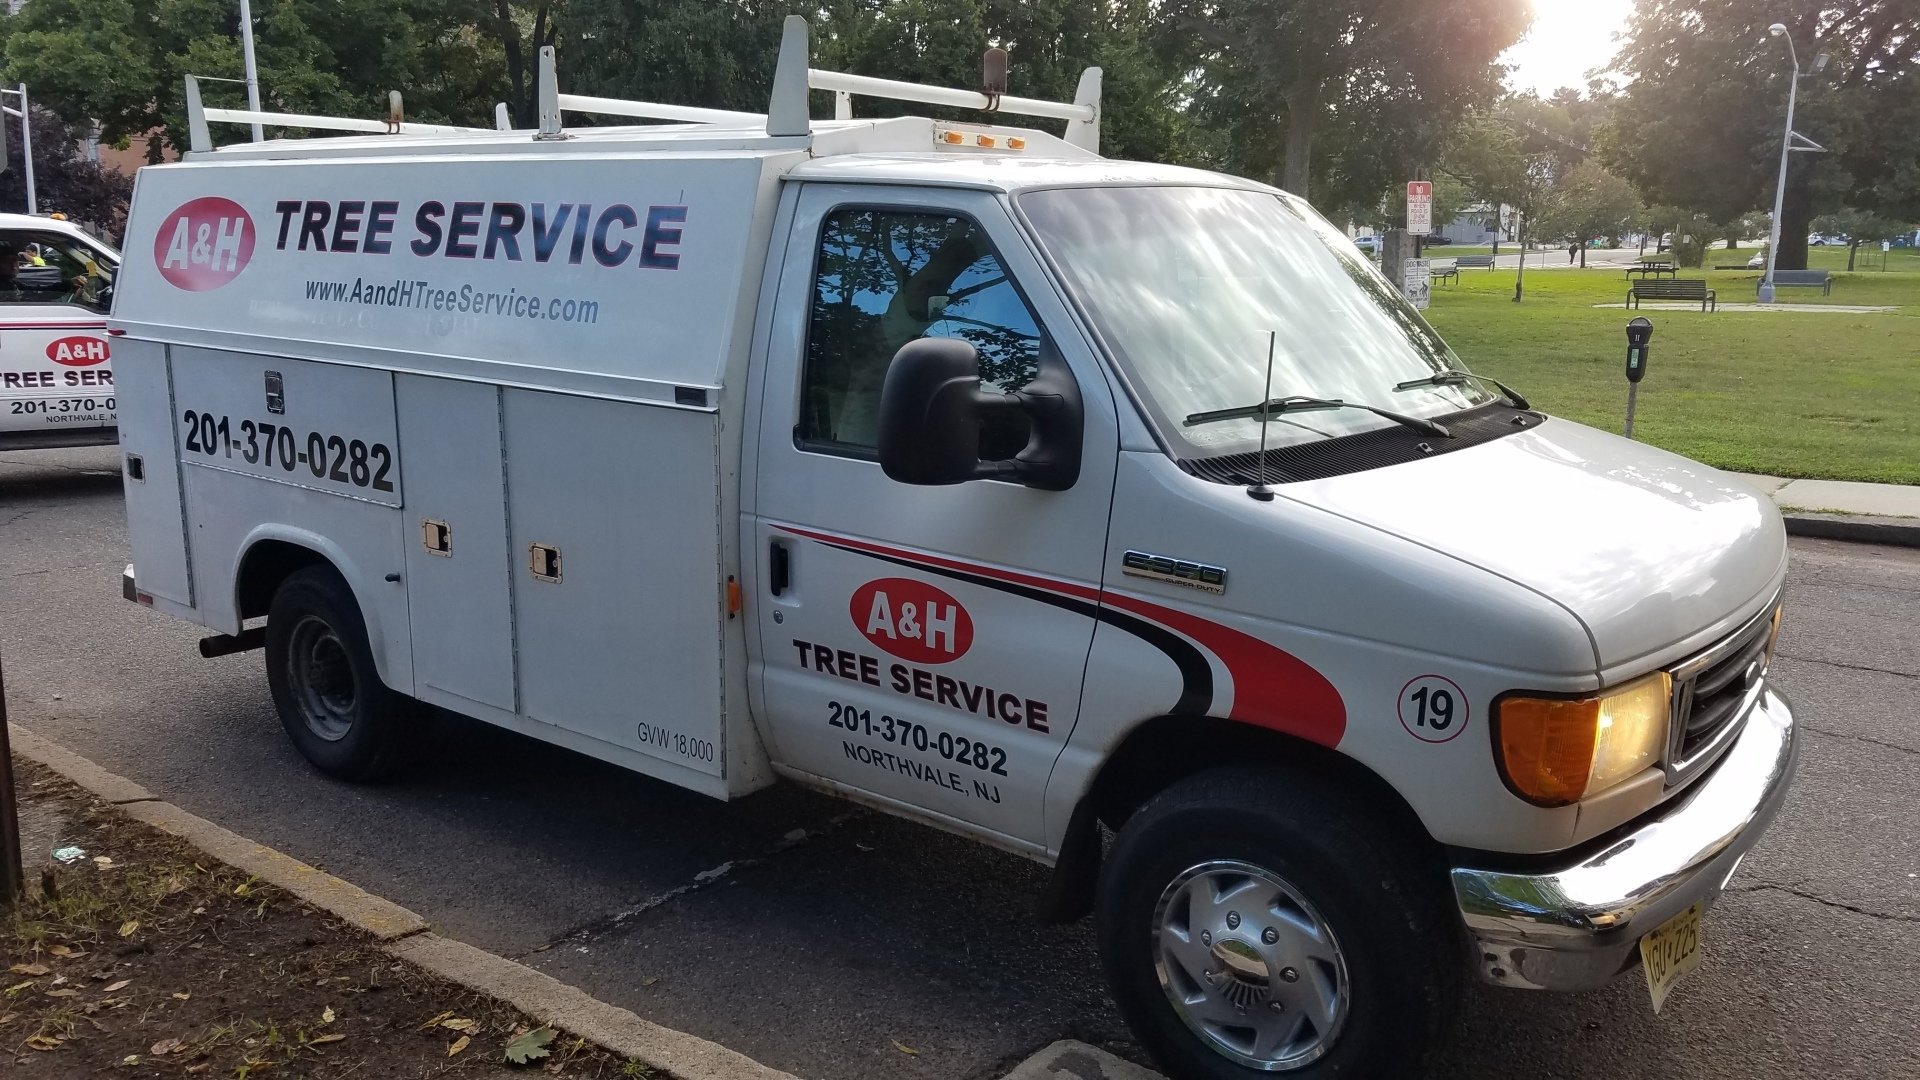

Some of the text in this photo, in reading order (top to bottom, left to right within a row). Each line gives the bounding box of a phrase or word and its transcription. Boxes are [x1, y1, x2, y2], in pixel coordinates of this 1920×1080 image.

[1409, 194, 1431, 203] PARKING
[1416, 185, 1424, 194] NO
[163, 216, 245, 273] A&H
[275, 200, 689, 271] TREE SERVICE
[305, 277, 599, 324] www.AandHTreeService.com
[55, 342, 105, 361] A&H
[0, 371, 55, 389] REE
[184, 409, 394, 493] 201-370-0282
[1165, 577, 1221, 593] SUPER DUTY
[866, 591, 957, 654] A&H
[792, 638, 1050, 734] TREE SERVICE
[1411, 686, 1454, 731] 19
[637, 722, 714, 762] GVW 18,000
[828, 700, 1008, 777] 201-370-0282
[842, 740, 1001, 804] NORTHVALE, NJ
